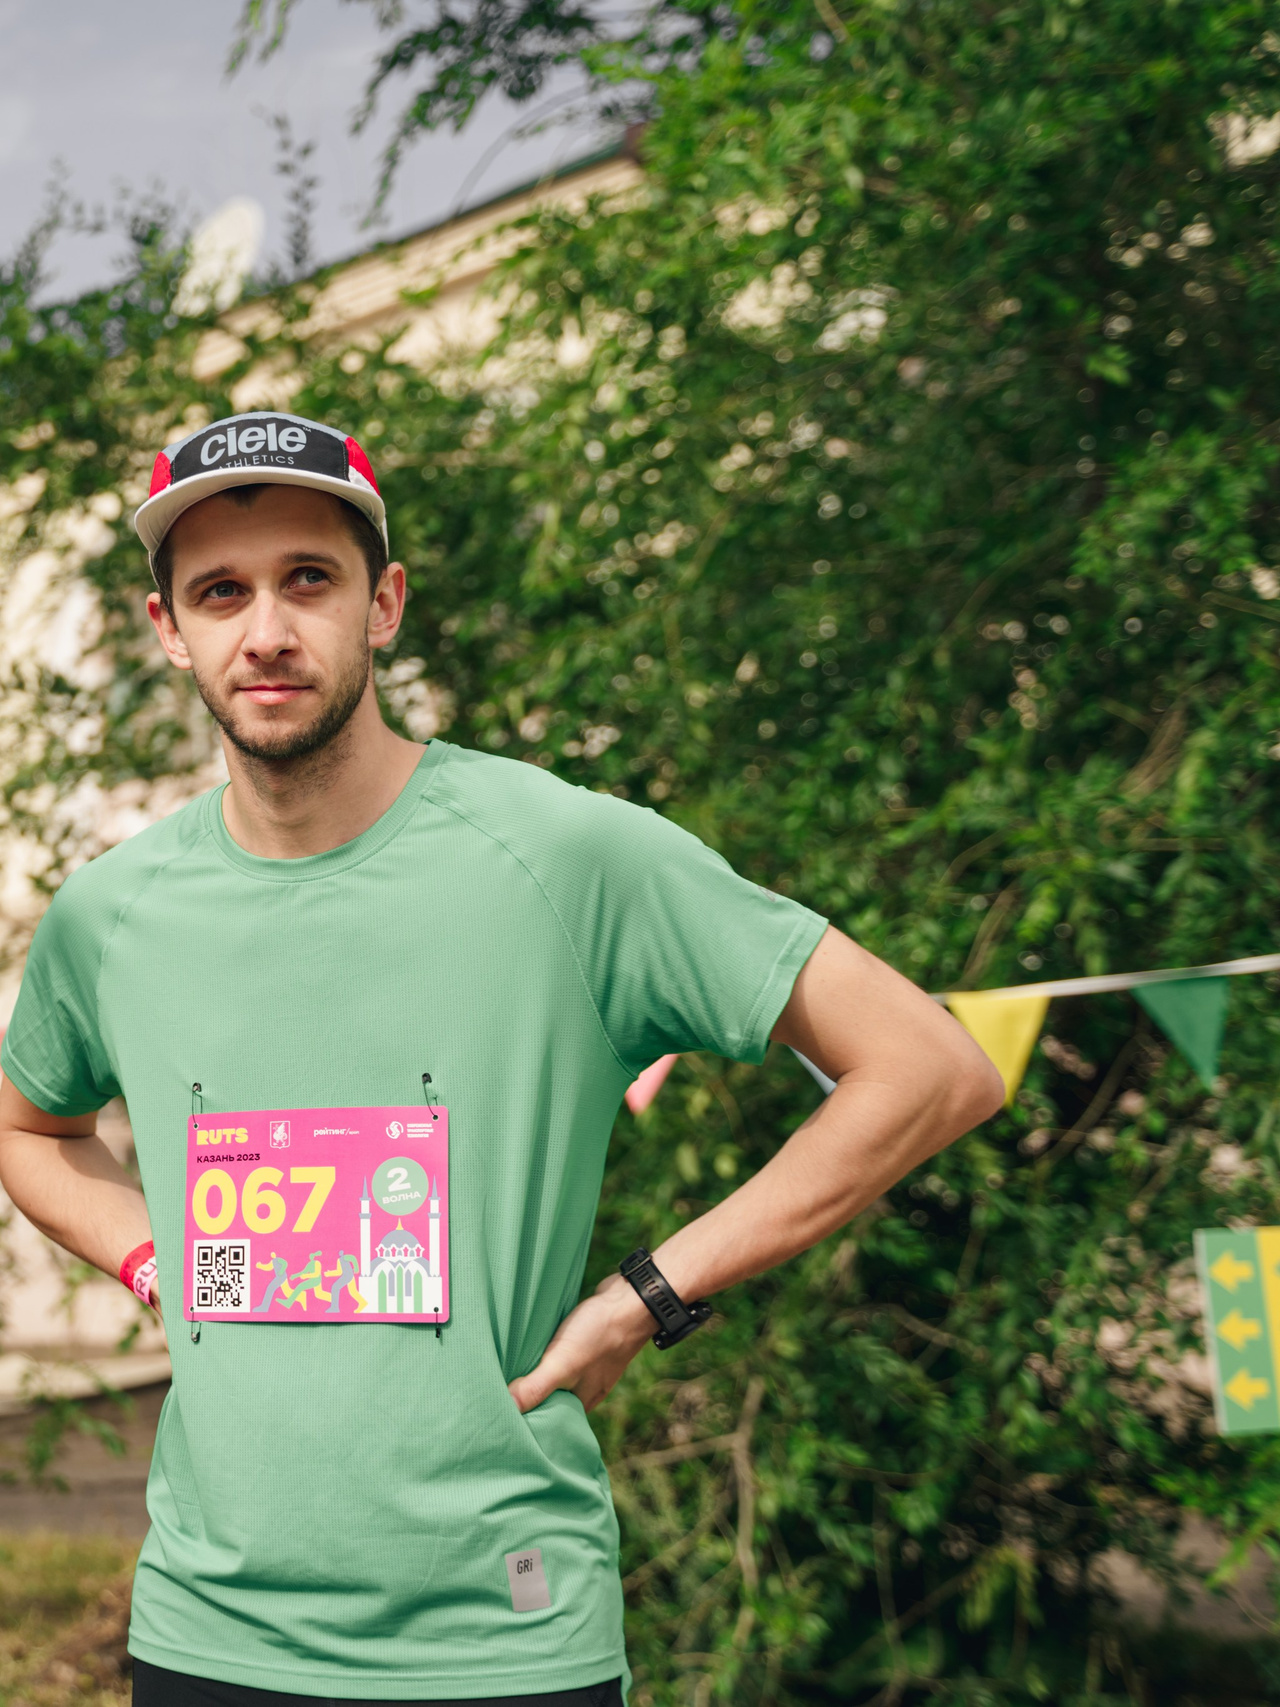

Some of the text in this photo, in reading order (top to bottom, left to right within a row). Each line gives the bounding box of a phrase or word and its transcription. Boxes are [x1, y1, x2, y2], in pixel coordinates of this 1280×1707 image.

[218, 455, 295, 469] THLETICS
[196, 1127, 249, 1145] RUTS
[196, 1153, 261, 1163] КАЗАНЬ 2023
[387, 1167, 412, 1192] 2
[192, 1166, 336, 1235] 067
[382, 1191, 421, 1204] ВОЛНА
